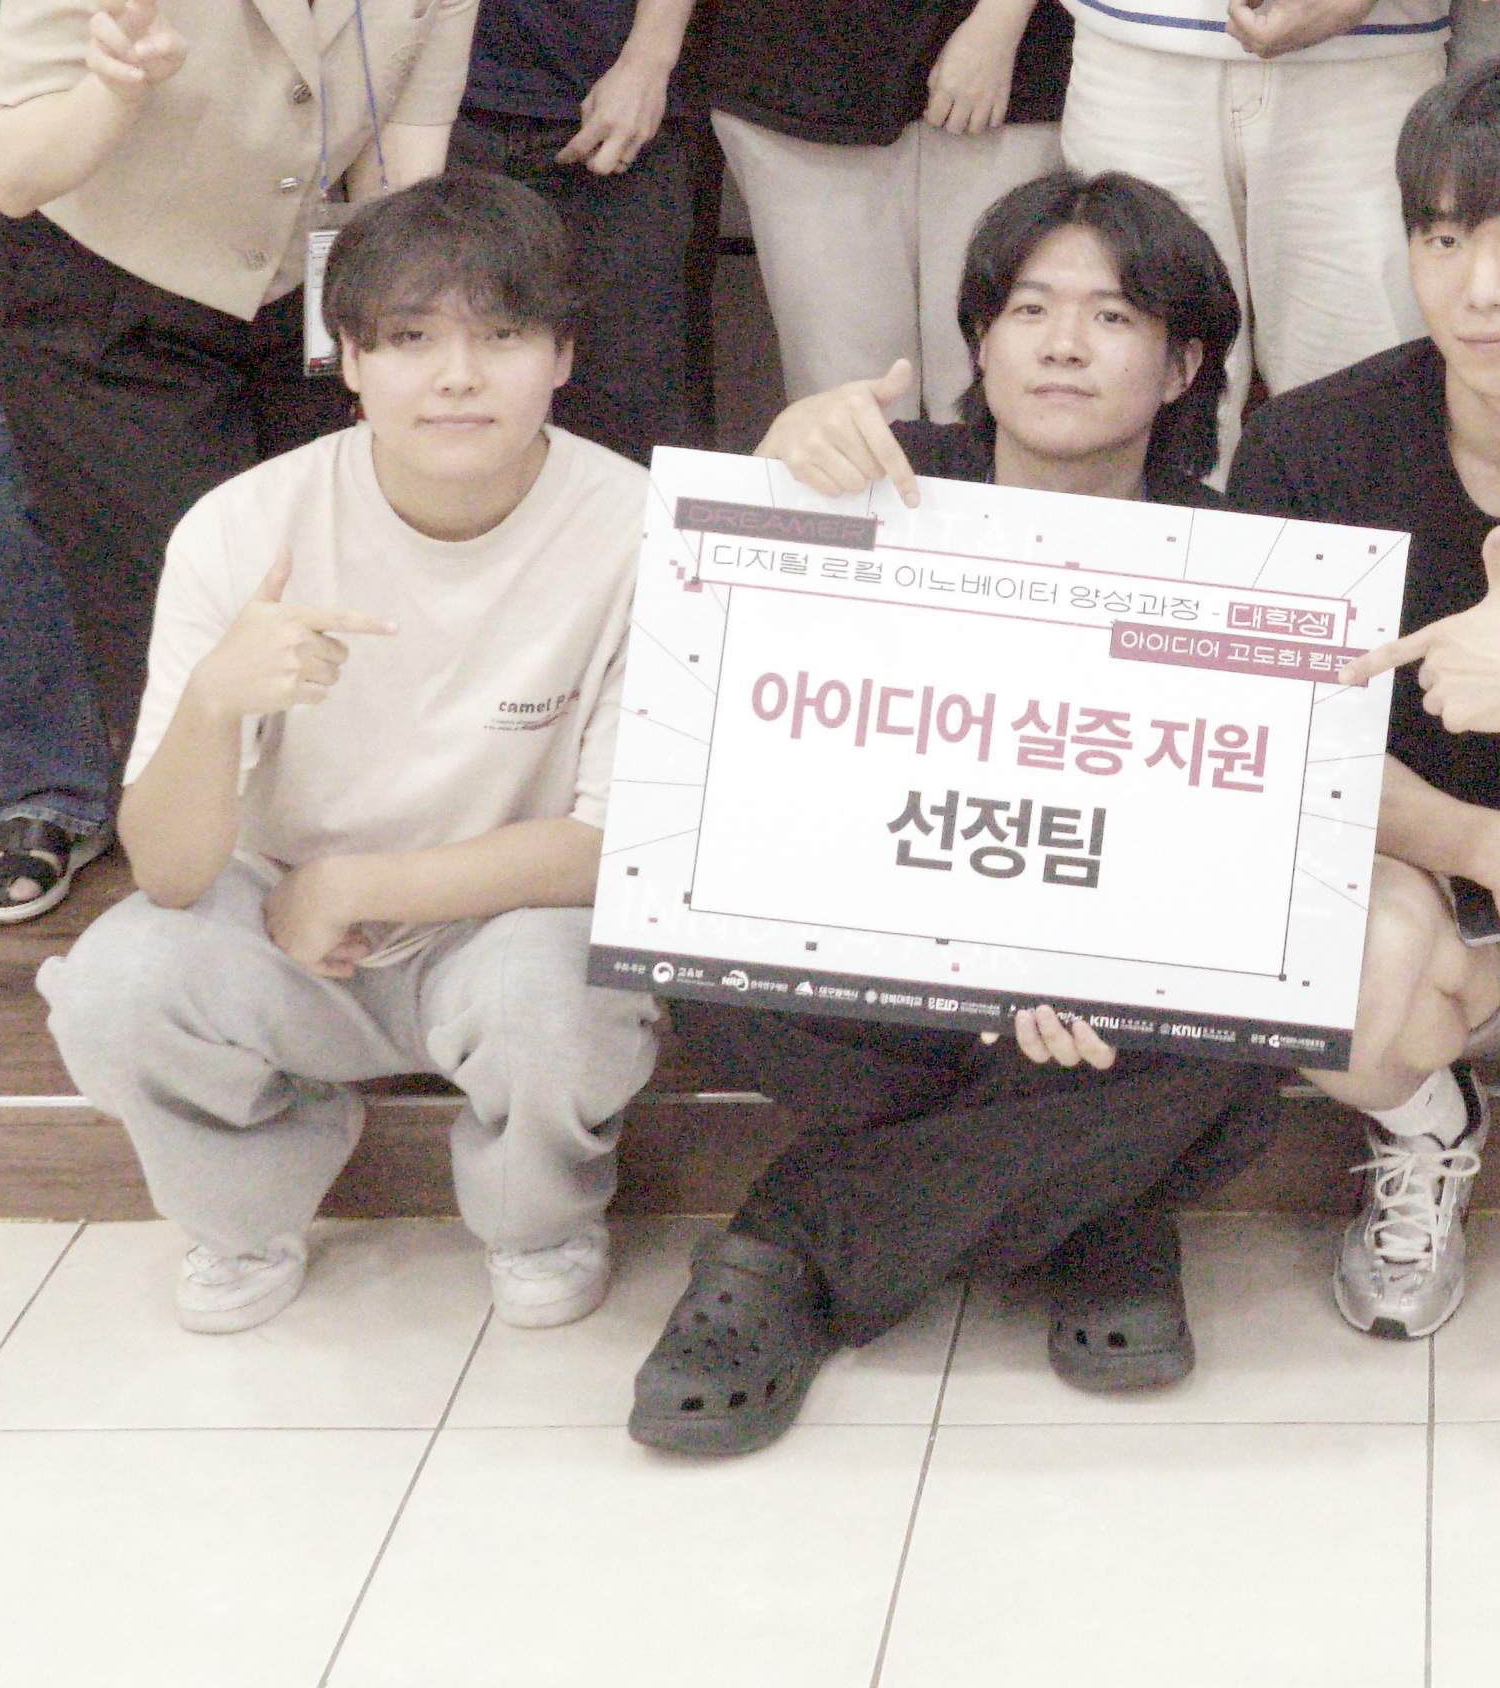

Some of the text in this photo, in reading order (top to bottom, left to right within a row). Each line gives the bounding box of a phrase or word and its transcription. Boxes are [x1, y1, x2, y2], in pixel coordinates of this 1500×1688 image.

[713, 544, 1333, 638] 디지털 로컬 이노베이터 양성과정 대학생
[1121, 629, 1302, 669] 아이디어 고도화
[499, 699, 550, 713] camel
[751, 671, 1268, 793] 아이디어 실증 지원
[887, 790, 1108, 888] 선정팀
